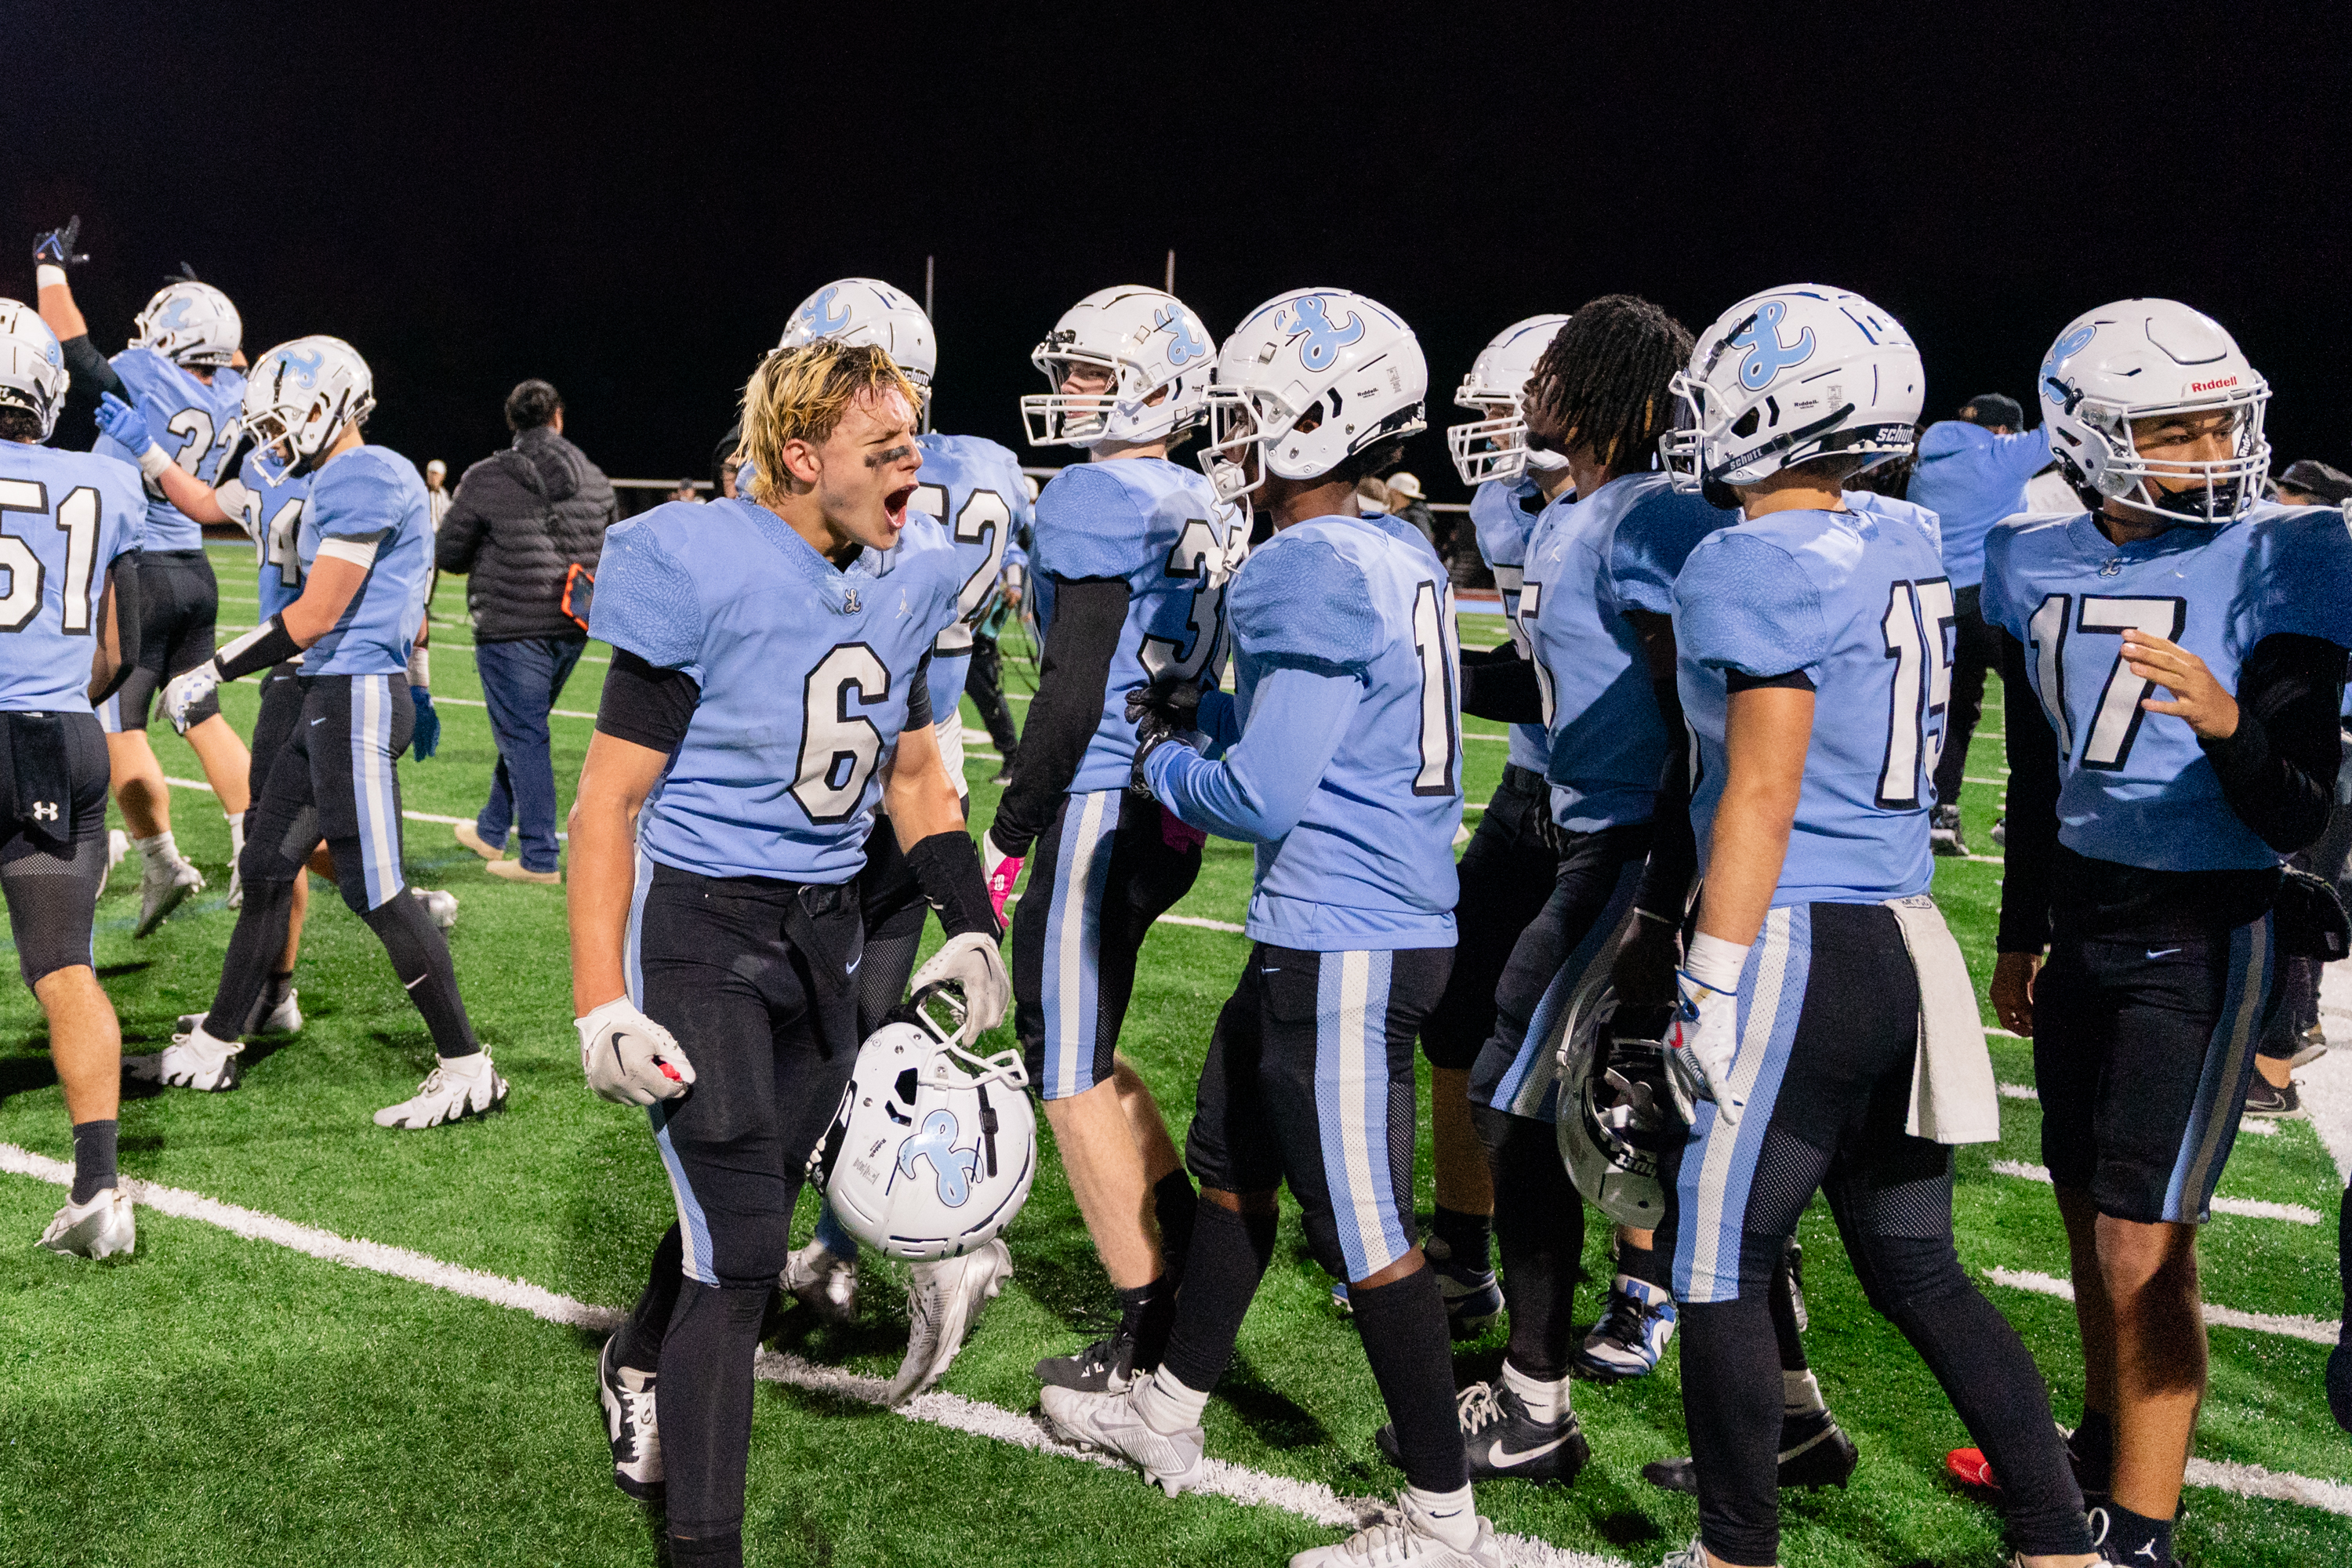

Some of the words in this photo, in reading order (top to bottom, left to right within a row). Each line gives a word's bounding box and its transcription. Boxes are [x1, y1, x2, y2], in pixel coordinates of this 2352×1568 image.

[1275, 296, 1365, 372] L
[1730, 300, 1816, 391] L
[2191, 376, 2238, 392] Riddell
[1730, 448, 1763, 470] schutt
[0, 477, 102, 636] 51
[844, 588, 862, 615] L
[1875, 576, 1957, 810] 15
[2028, 593, 2187, 771] 17
[789, 641, 891, 825] 6
[898, 1109, 984, 1208] L
